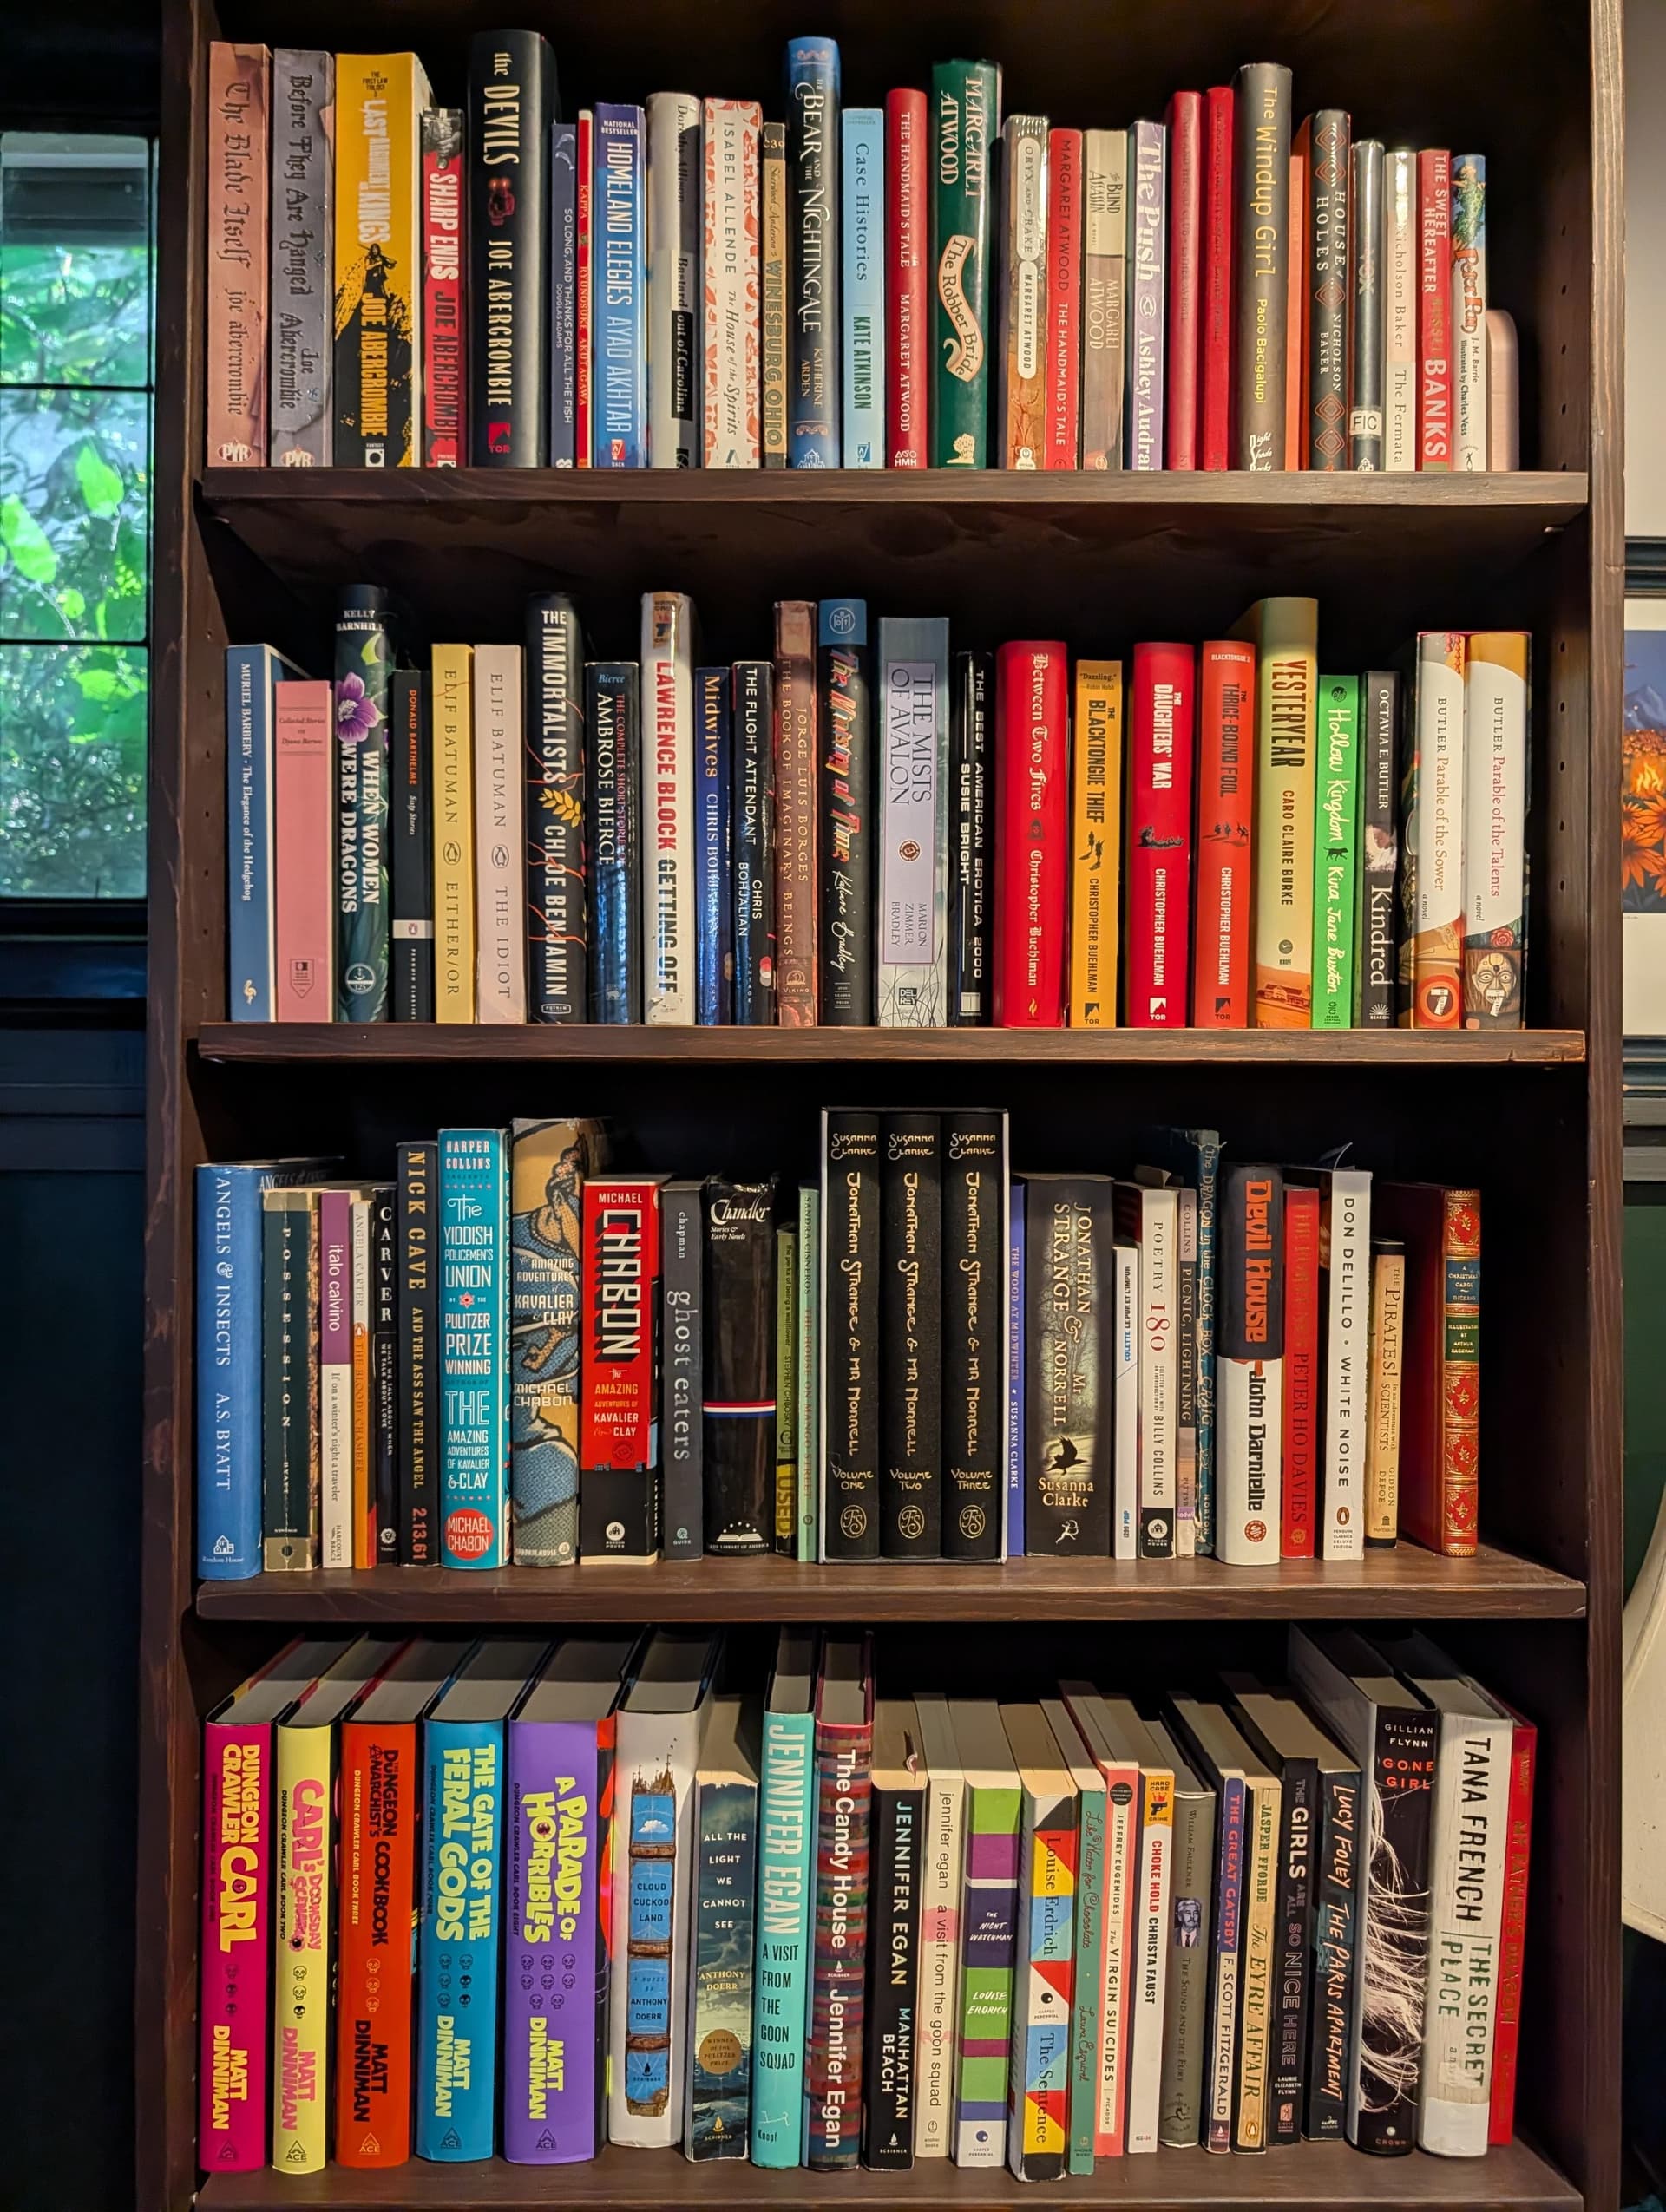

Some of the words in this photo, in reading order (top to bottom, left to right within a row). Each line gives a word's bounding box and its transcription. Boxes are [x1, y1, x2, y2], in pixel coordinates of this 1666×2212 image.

[494, 52, 514, 76] the
[219, 82, 249, 123] The
[483, 86, 519, 165] DEVILS
[901, 112, 910, 140] THE
[1263, 87, 1278, 119] The
[223, 134, 251, 193] Blade
[607, 142, 633, 232] HOMELAND
[856, 143, 869, 186] Case
[900, 144, 910, 228] HANDMAID'S
[1250, 126, 1277, 217] Windup
[430, 174, 458, 230] SHARP
[564, 208, 572, 222] SO
[218, 204, 251, 268] Itself
[430, 235, 459, 279] ENDS
[488, 240, 513, 269] JOE
[563, 226, 572, 257] LONG,
[856, 196, 870, 281] Histories
[901, 233, 910, 268] TALE
[1255, 226, 1277, 278] Girl
[607, 240, 633, 305] ELEGIES
[487, 279, 512, 406] ABERCROMBIE
[607, 316, 632, 359] AYAD
[853, 317, 871, 344] KATE
[900, 294, 910, 368] MARGARET
[1256, 299, 1268, 335] Paolo
[854, 349, 872, 409] ATKINSON
[1254, 338, 1268, 403] Bacigalupi
[1394, 370, 1407, 398] The
[607, 366, 632, 433] AKHTAR
[900, 374, 910, 432] ATWOOD
[1394, 403, 1407, 463] Fermata
[241, 664, 252, 705] MURIEL
[542, 629, 567, 782] IMMORTALISTS
[744, 669, 756, 697] THE
[974, 671, 984, 702] THE
[242, 709, 253, 757] BARBERY
[656, 662, 675, 774] LAWRENCE
[744, 700, 757, 754] FLIGHT
[974, 711, 984, 752] BEST
[1151, 684, 1173, 757] DAUGHTERS'
[1270, 660, 1307, 767] YESTERYEAR
[1493, 697, 1503, 753] BUTLER
[243, 766, 252, 783] The
[341, 743, 357, 802] WERE
[362, 751, 380, 814] WHEN
[1152, 762, 1172, 789] WAR
[1492, 756, 1505, 805] Parable
[240, 787, 253, 825] Elegance
[657, 782, 676, 850] BLOCK
[744, 758, 757, 845] ATTENDANT
[974, 763, 983, 848] AMERICAN
[1282, 790, 1295, 819] CARO
[1492, 808, 1504, 821] of
[243, 828, 253, 837] of
[243, 840, 253, 854] the
[544, 825, 566, 887] CHLOE
[1282, 825, 1295, 864] CLAIRE
[1492, 824, 1504, 845] the
[240, 856, 253, 900] Hedgehog
[341, 812, 357, 913] DRAGONS
[363, 824, 380, 904] WOMEN
[1281, 869, 1294, 906] BURKE
[1491, 848, 1504, 897] Talents
[658, 859, 676, 948] GETTING
[974, 858, 983, 926] EROTICA
[1154, 868, 1166, 933] CHRISTOPHER
[545, 895, 567, 995] BENJAMIN
[973, 937, 983, 978] 2000
[1153, 936, 1165, 985] BUEHLMAN
[1370, 885, 1392, 986] Kindred
[659, 955, 677, 993] OFF
[408, 1151, 426, 1214] NICK
[217, 1178, 230, 1254] ANGELS
[675, 1212, 687, 1259] chapman
[966, 1172, 981, 1253] JONATHAN
[1245, 1180, 1271, 1250] Devil
[1342, 1197, 1355, 1238] DON
[217, 1262, 233, 1278] &
[329, 1244, 343, 1275] italo
[409, 1228, 426, 1290] CAVE
[600, 1209, 642, 1357] CHABON
[1151, 1221, 1164, 1293] POETRY
[329, 1281, 343, 1332] calvino
[960, 1259, 981, 1331] STRANGE
[1246, 1260, 1272, 1342] House
[1341, 1248, 1355, 1329] DELILLO
[216, 1286, 231, 1365] INSECTS
[666, 1291, 699, 1366] ghost
[968, 1338, 980, 1351] &
[1145, 1302, 1171, 1352] 180
[331, 1372, 340, 1381] If
[331, 1384, 338, 1394] on
[967, 1358, 979, 1380] MR
[1247, 1371, 1267, 1418] John
[1340, 1357, 1353, 1418] WHITE
[217, 1393, 231, 1422] A.S.
[331, 1404, 340, 1436] winter's
[673, 1378, 691, 1460] eaters
[967, 1388, 980, 1456] NORRELL
[1152, 1416, 1164, 1444] BILLY
[216, 1430, 230, 1490] BYATT
[329, 1438, 340, 1460] night
[1151, 1450, 1165, 1495] COLLINS
[1247, 1424, 1267, 1511] Darnielle
[1339, 1429, 1351, 1488] NOISE
[331, 1469, 340, 1502] traveler
[412, 1508, 427, 1560] 2.13.61
[221, 1744, 243, 1842] CRAWLER
[241, 1744, 260, 1842] DUNGEON
[837, 1749, 856, 1792] The
[1461, 1738, 1492, 1803] TANA
[830, 1797, 855, 1869] Candy
[939, 1791, 954, 1847] jennifer
[1229, 1796, 1240, 1827] THE
[893, 1802, 913, 1913] JENNIFER
[935, 1853, 951, 1888] egan
[1046, 1837, 1061, 1890] Louise
[1149, 1841, 1164, 1878] CHOKE
[1227, 1830, 1240, 1884] GREAT
[1456, 1815, 1489, 1921] FRENCH
[219, 1846, 258, 1953] CARL
[830, 1875, 852, 1948] House
[1148, 1882, 1161, 1913] HOLD
[1223, 1888, 1237, 1947] GATSBY
[935, 1918, 950, 1948] visit
[1043, 1896, 1060, 1955] Erdrich
[1145, 1917, 1160, 1965] CHRISTA
[890, 1922, 908, 1985] EGAN
[933, 1953, 948, 1986] from
[932, 1992, 947, 2014] the
[1145, 1969, 1158, 2004] FAUST
[829, 1989, 849, 2084] Jennifer
[881, 2034, 897, 2092] BEACH
[895, 2008, 912, 2119] MANHATTAN
[928, 2020, 942, 2057] goon
[1039, 2033, 1055, 2065] The
[213, 2025, 232, 2129] DINNIMAN
[228, 2049, 248, 2101] MATT
[927, 2061, 944, 2106] squad
[823, 2091, 844, 2148] Egan
[1036, 2070, 1053, 2143] Sentence
